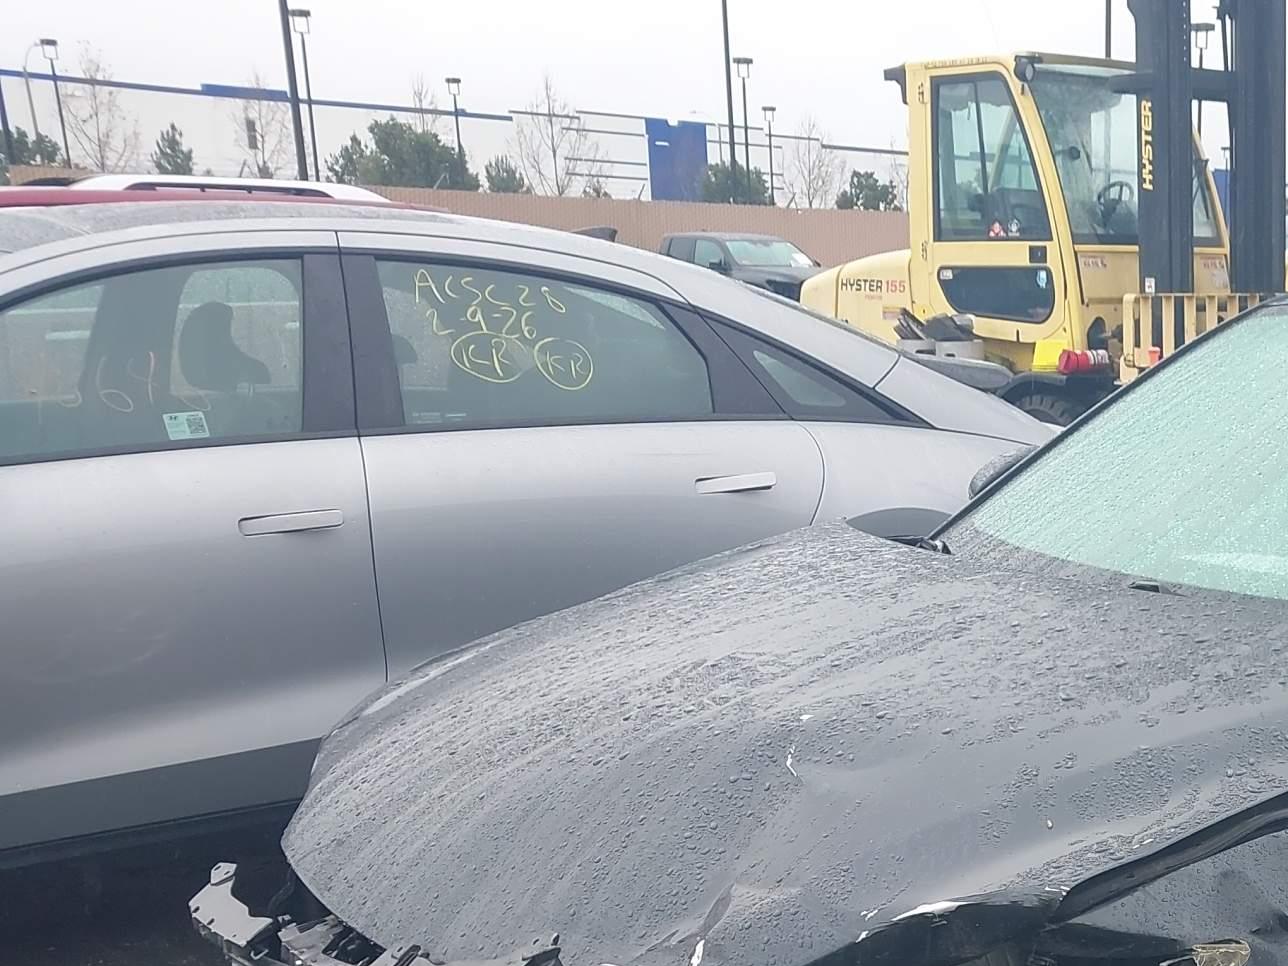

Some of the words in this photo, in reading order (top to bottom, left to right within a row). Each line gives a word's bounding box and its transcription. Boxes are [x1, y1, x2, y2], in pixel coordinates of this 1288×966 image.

[1140, 99, 1154, 191] HYSTER
[840, 278, 883, 293] HYSTER
[885, 279, 906, 294] 155
